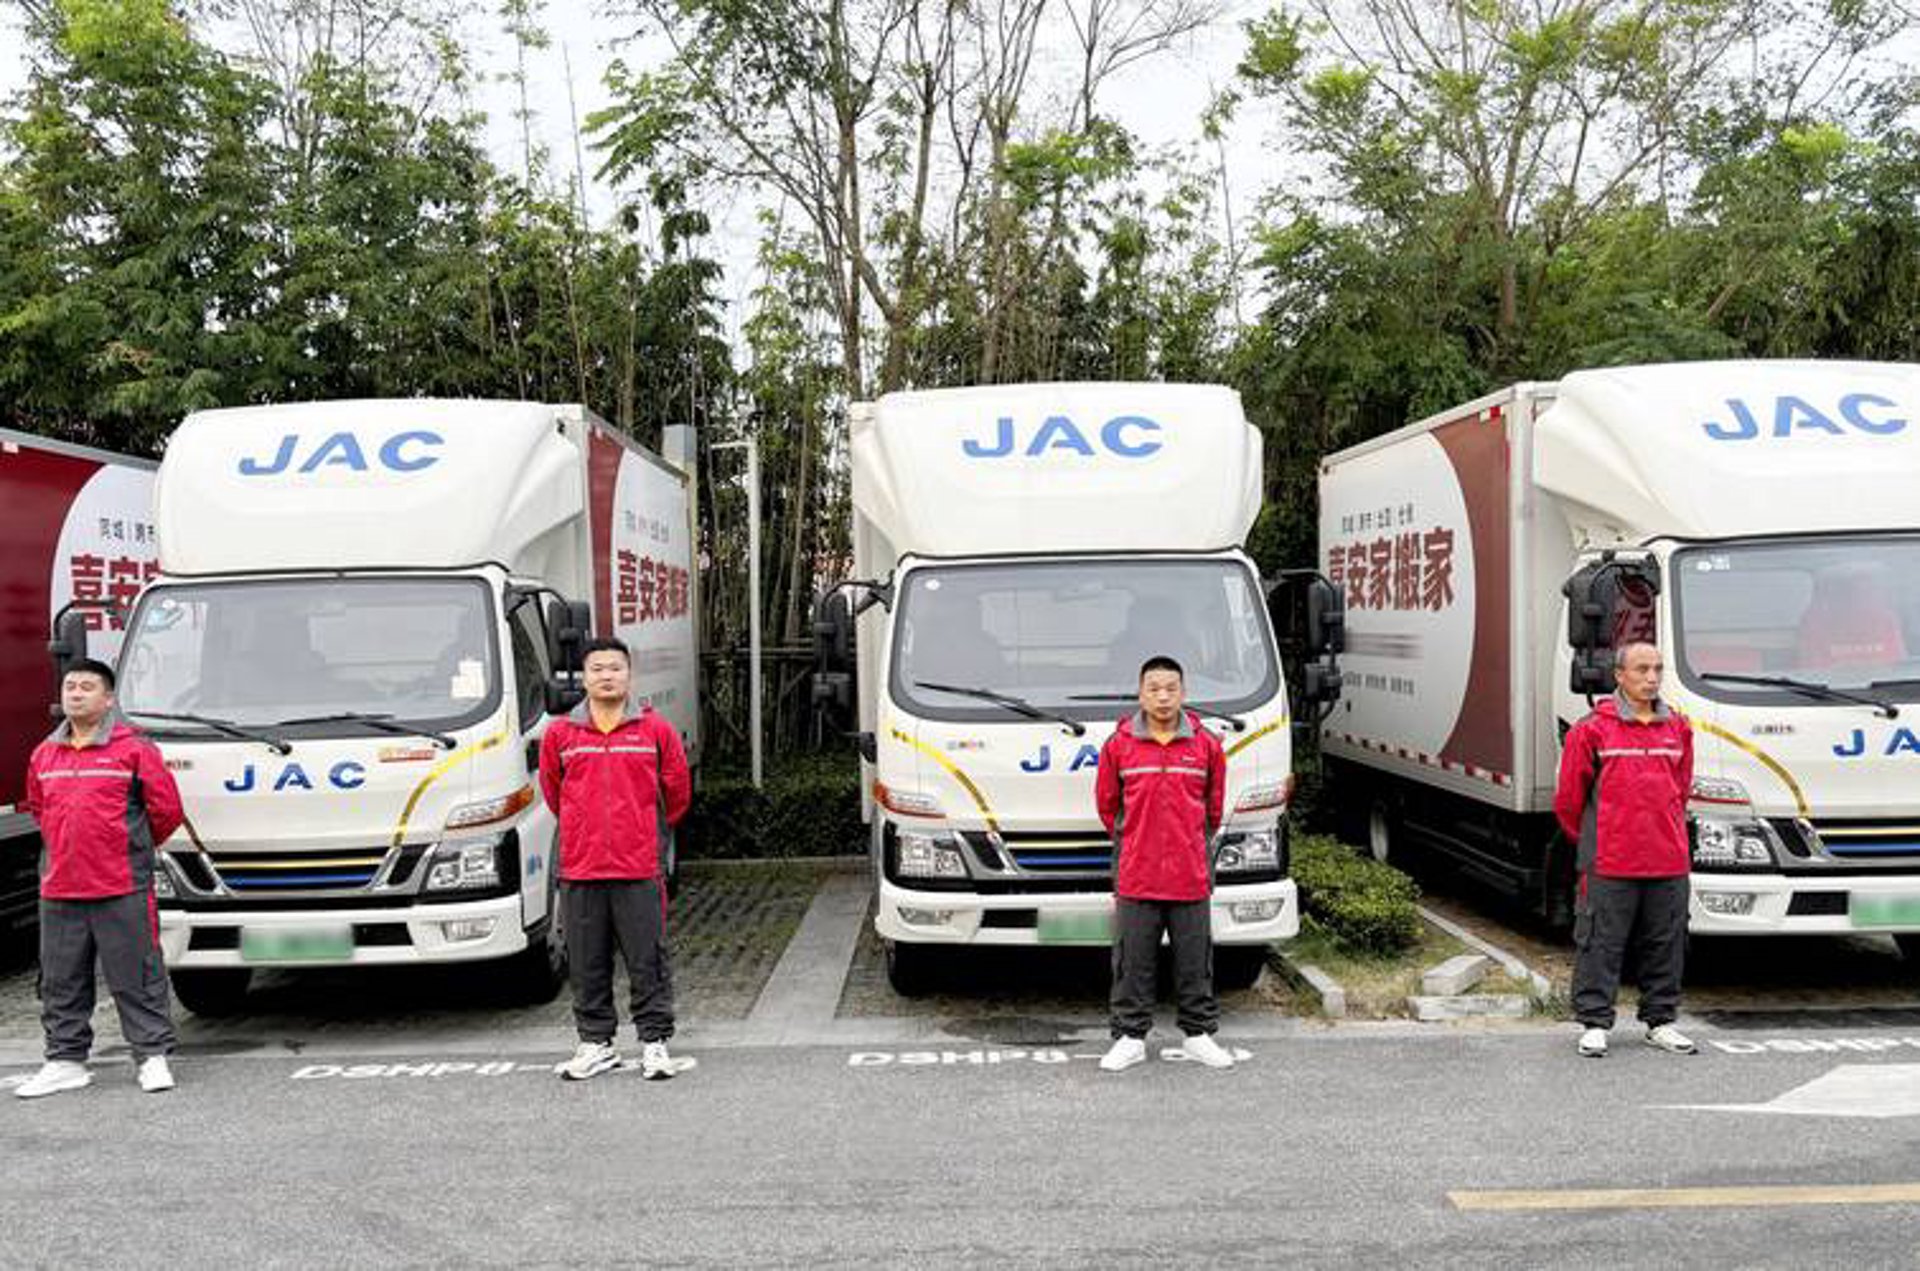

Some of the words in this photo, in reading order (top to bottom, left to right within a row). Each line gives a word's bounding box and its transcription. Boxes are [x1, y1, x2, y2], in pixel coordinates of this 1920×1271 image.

[962, 415, 1163, 459] JAC
[1702, 393, 1907, 440] JAC
[239, 430, 445, 476] JAC
[1328, 525, 1454, 612] 喜安家搬家
[224, 761, 367, 792] JAC
